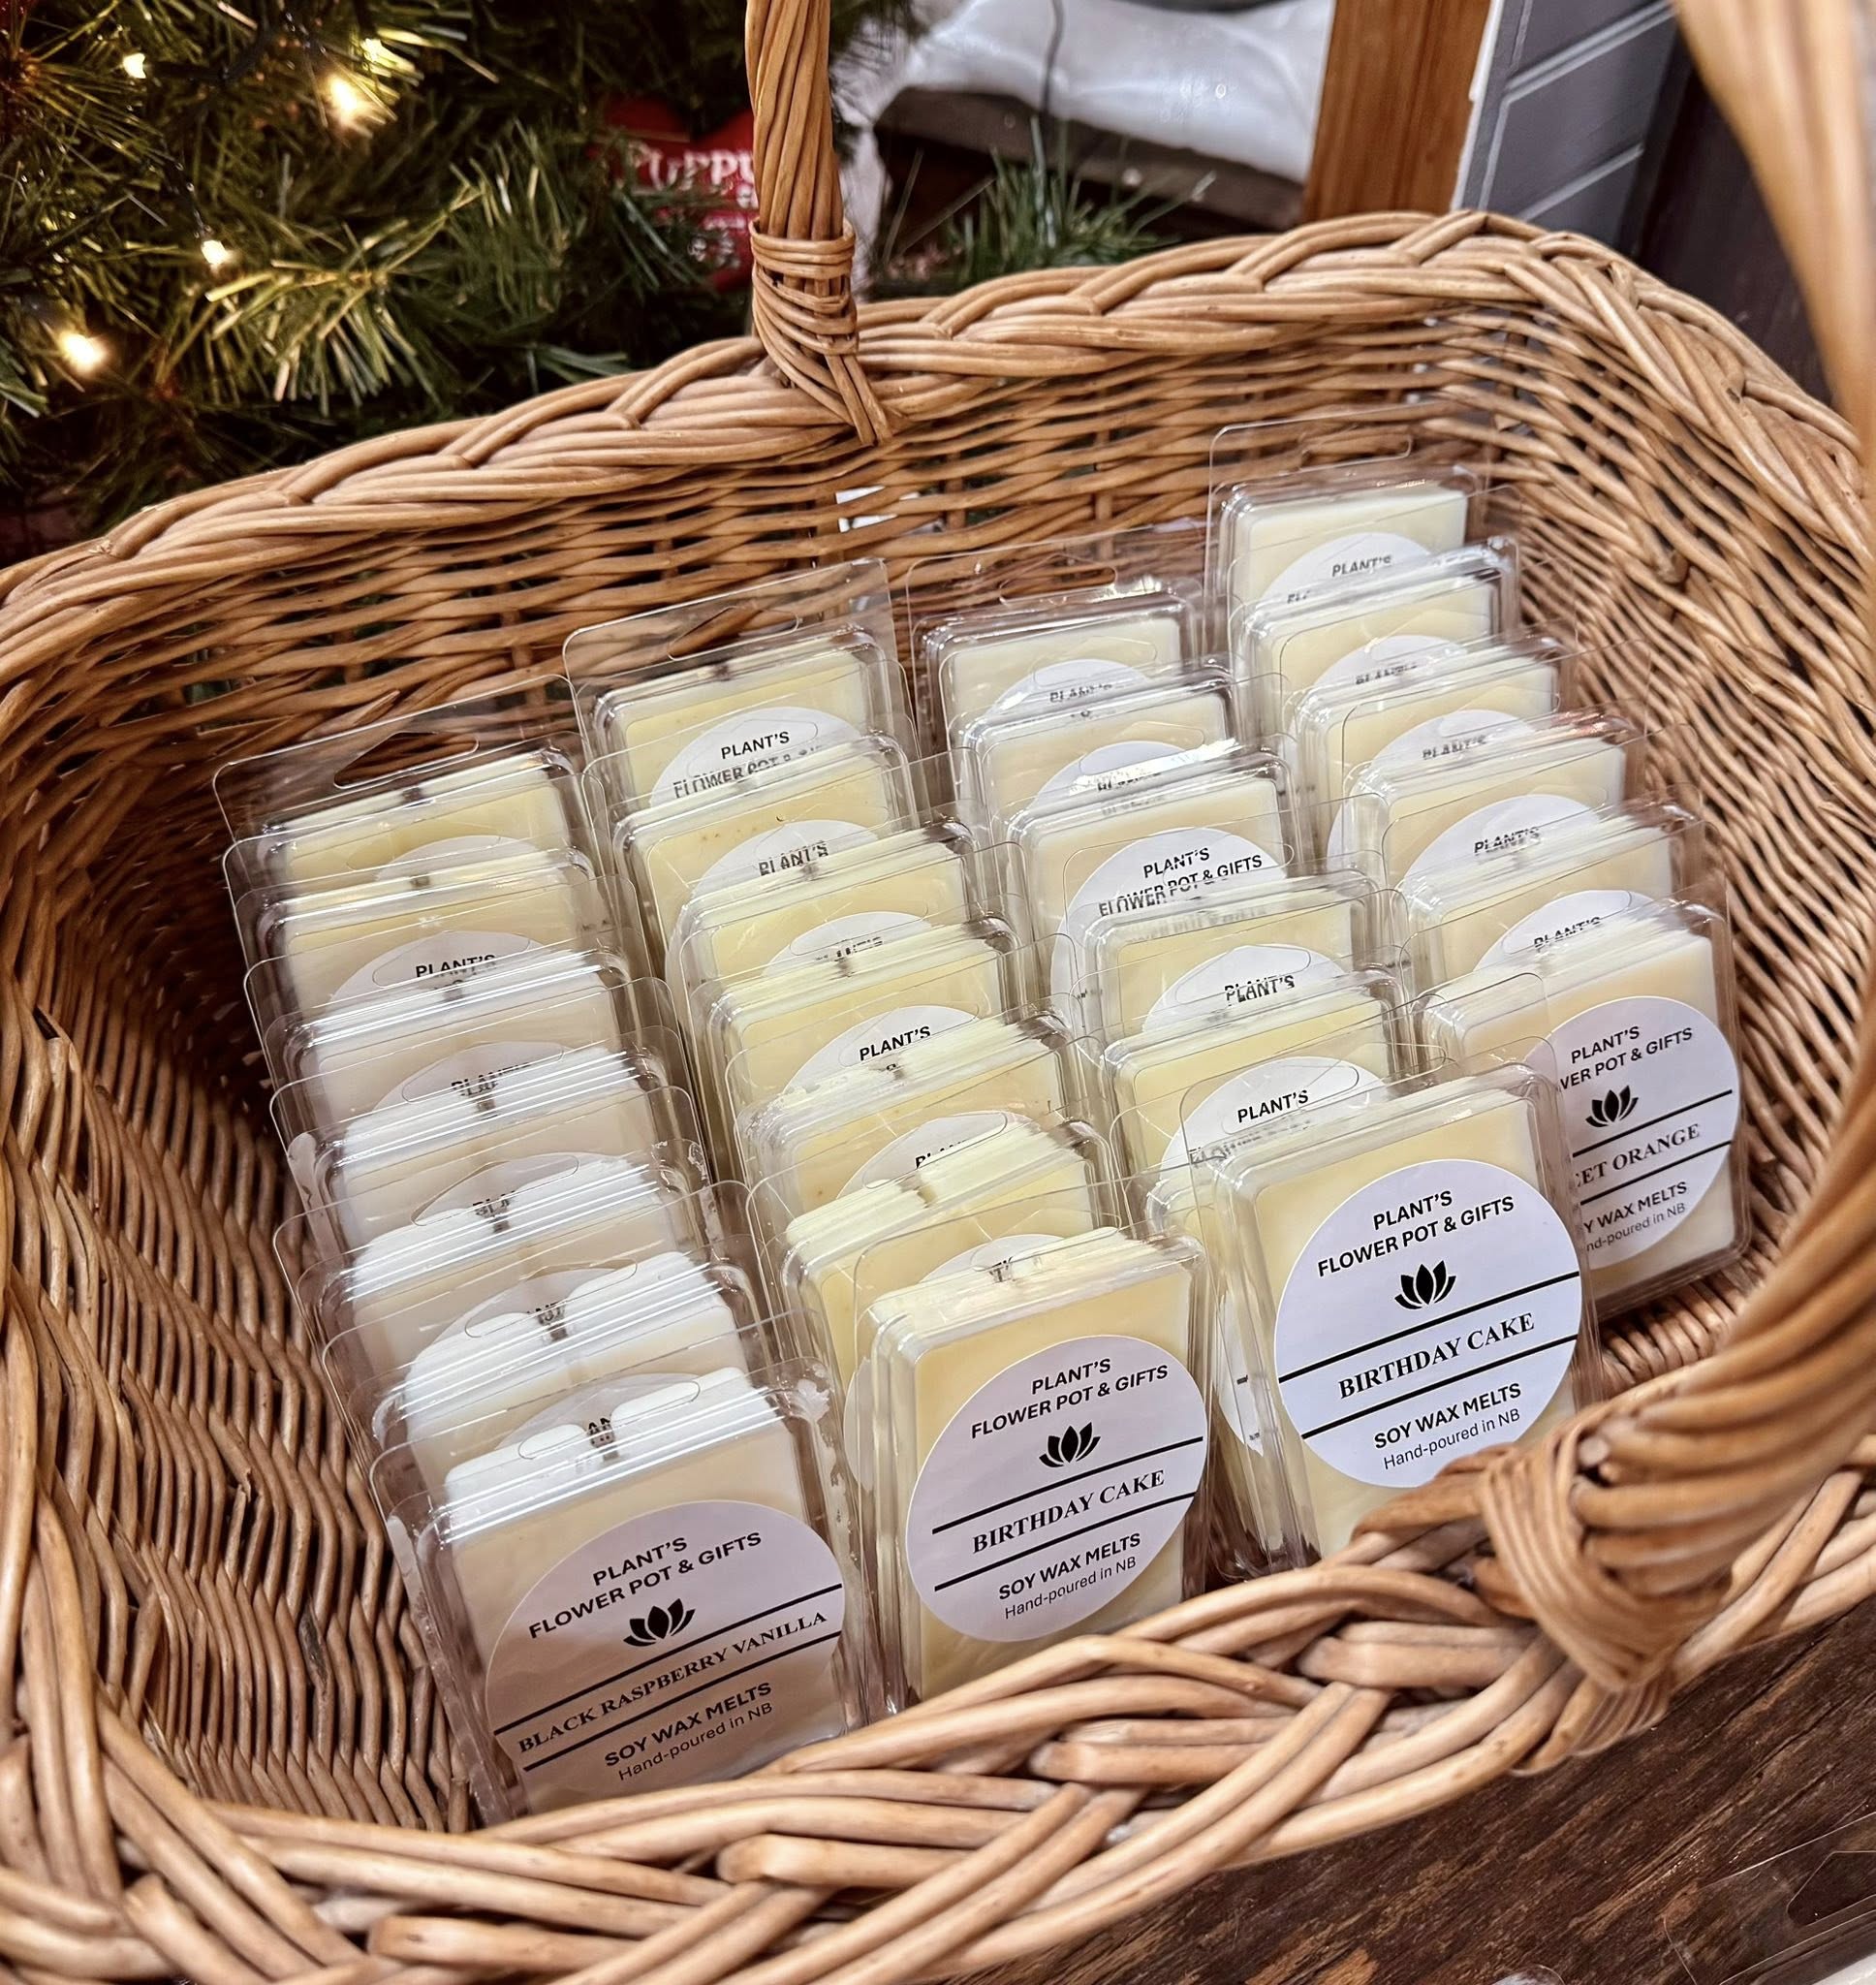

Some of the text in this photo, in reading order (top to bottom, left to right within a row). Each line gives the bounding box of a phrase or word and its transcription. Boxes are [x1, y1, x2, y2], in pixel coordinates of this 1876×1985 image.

[721, 731, 790, 760] PLANT'S
[1143, 847, 1210, 878] PLANT'S
[1217, 854, 1263, 879] GIFTS
[859, 1025, 931, 1061] PLANT'S
[1571, 1025, 1641, 1064] PLANT'S
[1595, 1053, 1627, 1076] POT
[1630, 1048, 1642, 1061] &
[1645, 1027, 1693, 1055] GIFTS
[1237, 1089, 1308, 1123] PLANT'S
[1611, 1123, 1701, 1171] ORANGE
[1372, 1190, 1453, 1230] PLANT'S
[1586, 1216, 1650, 1251] nd-poured
[1652, 1212, 1665, 1225] in
[1667, 1202, 1686, 1218] NB
[1597, 1202, 1636, 1228] WAX
[1638, 1181, 1687, 1212] MELTS
[1317, 1195, 1515, 1277] FLOWER POT & GIFTS
[1031, 1358, 1111, 1395] PLANT'S
[1338, 1311, 1536, 1400] BIRTHDAY CAKE
[971, 1364, 1168, 1439] FLOWER POT & GIFTS
[1374, 1382, 1521, 1450] SOY WAX MELTS
[1383, 1407, 1520, 1470] Hand-poured in NB
[972, 1469, 1166, 1554] BIRTHDAY CAKE
[528, 1531, 763, 1639] FLOWER POT & GIFTS
[592, 1536, 688, 1587] PLANT'S
[998, 1532, 1141, 1600] SOY WAX MELTS
[1004, 1555, 1137, 1620] Hand-poured in NB
[517, 1611, 828, 1754] BLACK RASPBERRY VANILLA
[604, 1682, 772, 1768] SOY WAX MELTS
[617, 1702, 773, 1780] Hand-poured in NB
